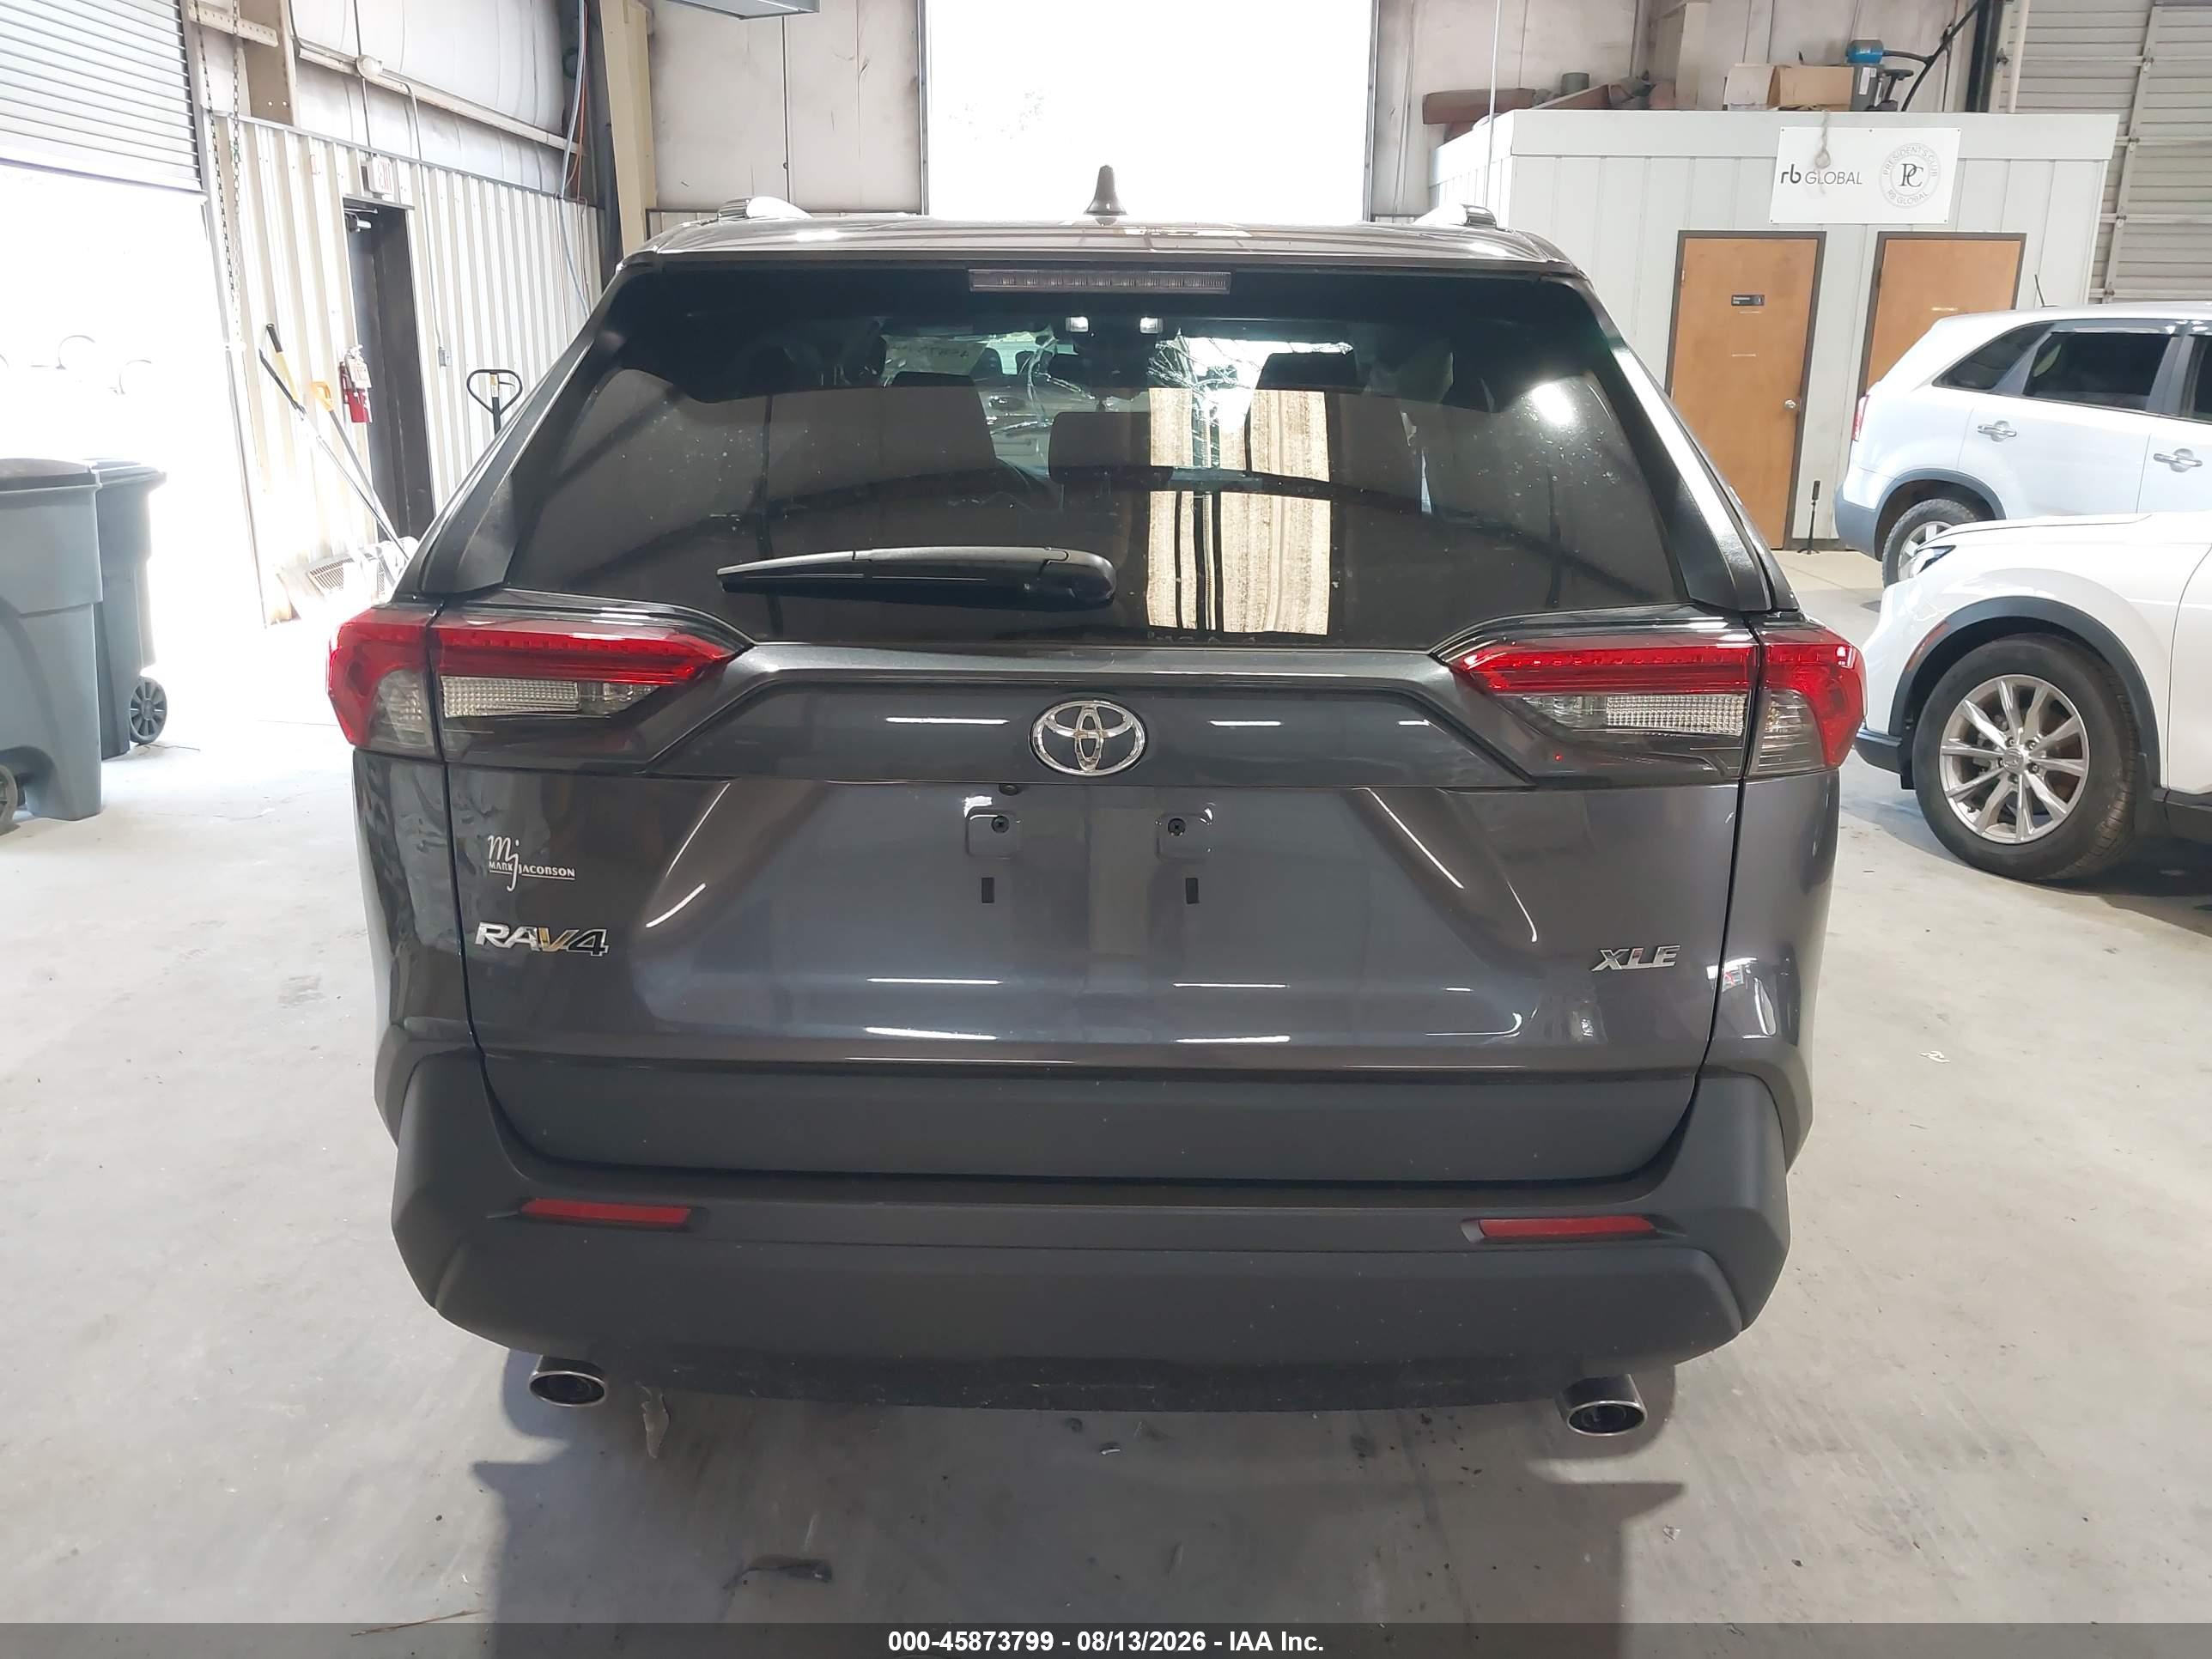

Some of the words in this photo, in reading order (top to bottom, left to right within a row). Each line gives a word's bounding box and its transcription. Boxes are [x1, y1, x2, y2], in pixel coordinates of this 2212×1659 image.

[1780, 164, 1802, 184] rb
[1805, 171, 1863, 185] GLOBAL
[1899, 162, 1924, 187] PC
[489, 861, 514, 872] MARK
[519, 864, 575, 877] JACOBSON
[475, 921, 610, 957] RAV4
[1591, 945, 1681, 971] XLE
